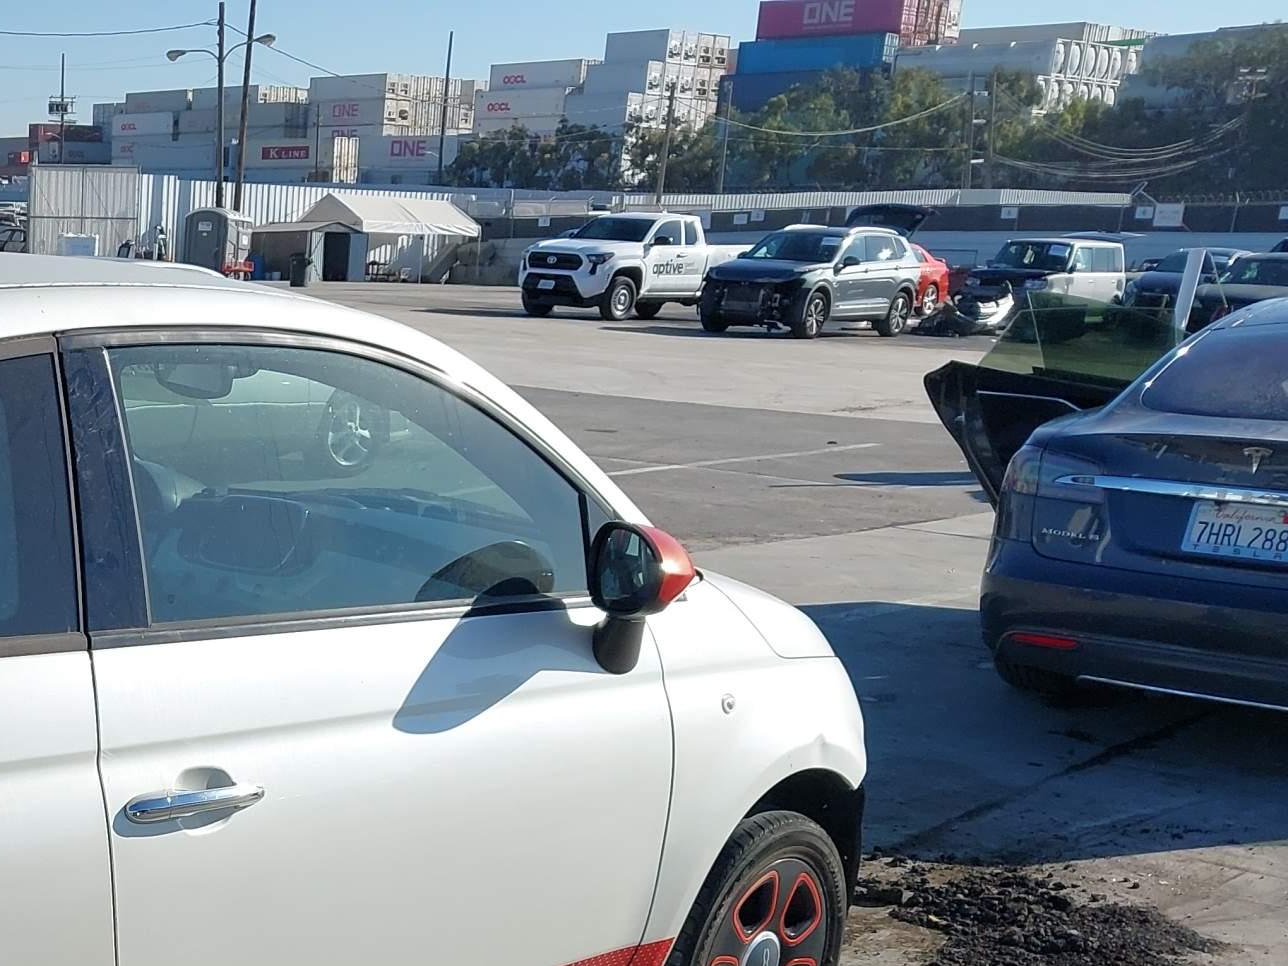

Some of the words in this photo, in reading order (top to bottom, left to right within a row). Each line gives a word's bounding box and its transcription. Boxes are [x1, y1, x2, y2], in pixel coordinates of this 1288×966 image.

[803, 0, 855, 24] ONE
[503, 75, 526, 84] OOCL
[332, 103, 359, 118] ONE
[487, 102, 510, 112] OOCL
[281, 150, 306, 159] LINE
[390, 140, 426, 157] ONE
[652, 259, 684, 278] aptive
[1041, 527, 1086, 540] MODEL
